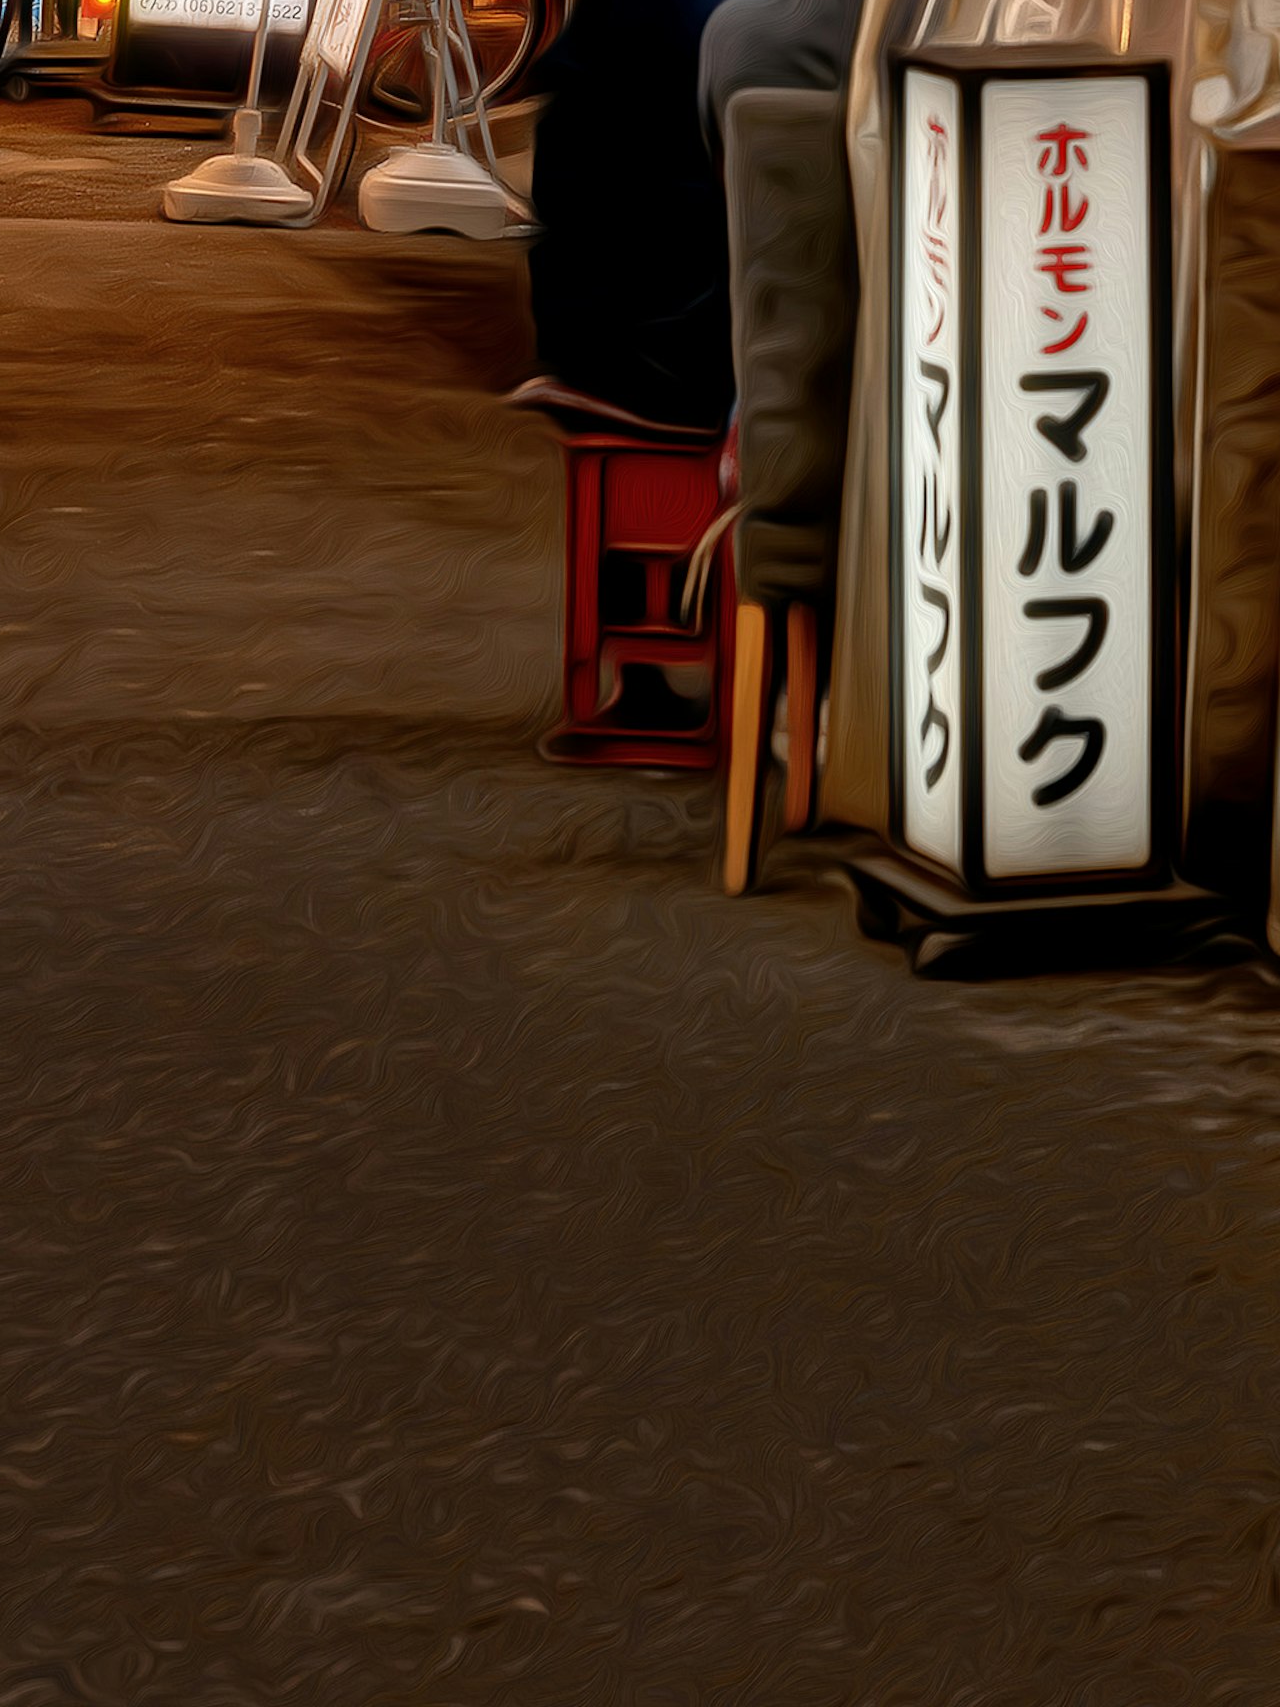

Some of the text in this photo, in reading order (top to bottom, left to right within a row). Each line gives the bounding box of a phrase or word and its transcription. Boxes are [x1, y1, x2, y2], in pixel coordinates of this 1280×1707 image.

[1018, 121, 1115, 809] ホルモン マルフク
